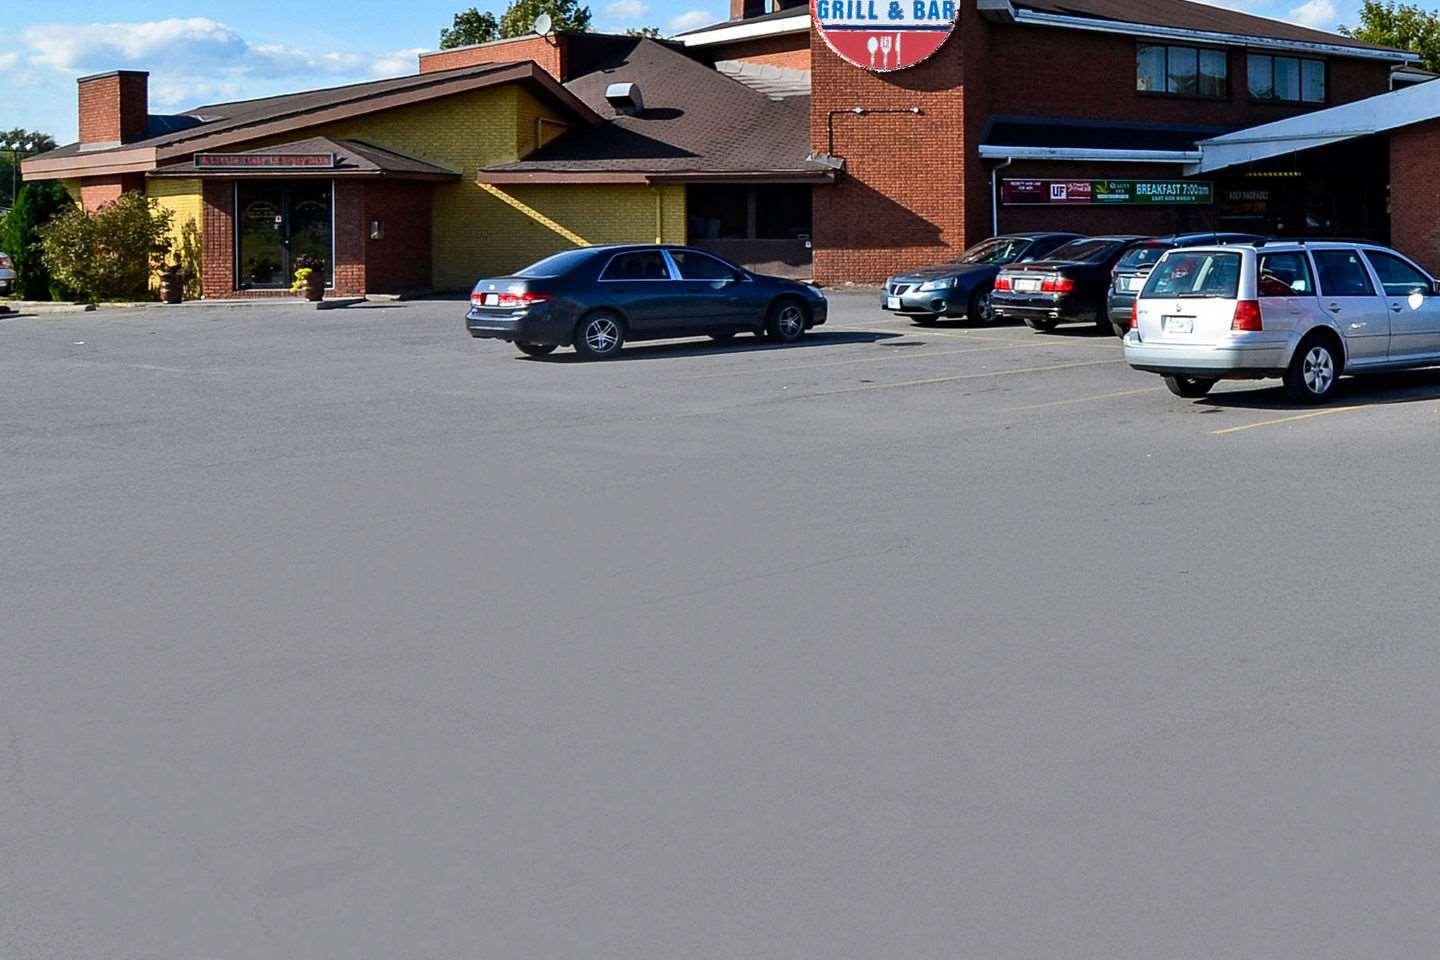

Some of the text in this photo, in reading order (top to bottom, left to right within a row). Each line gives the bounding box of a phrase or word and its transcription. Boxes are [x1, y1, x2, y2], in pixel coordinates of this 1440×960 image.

[817, 0, 955, 20] GRILL & BAR
[1136, 184, 1180, 195] BREAKFAST
